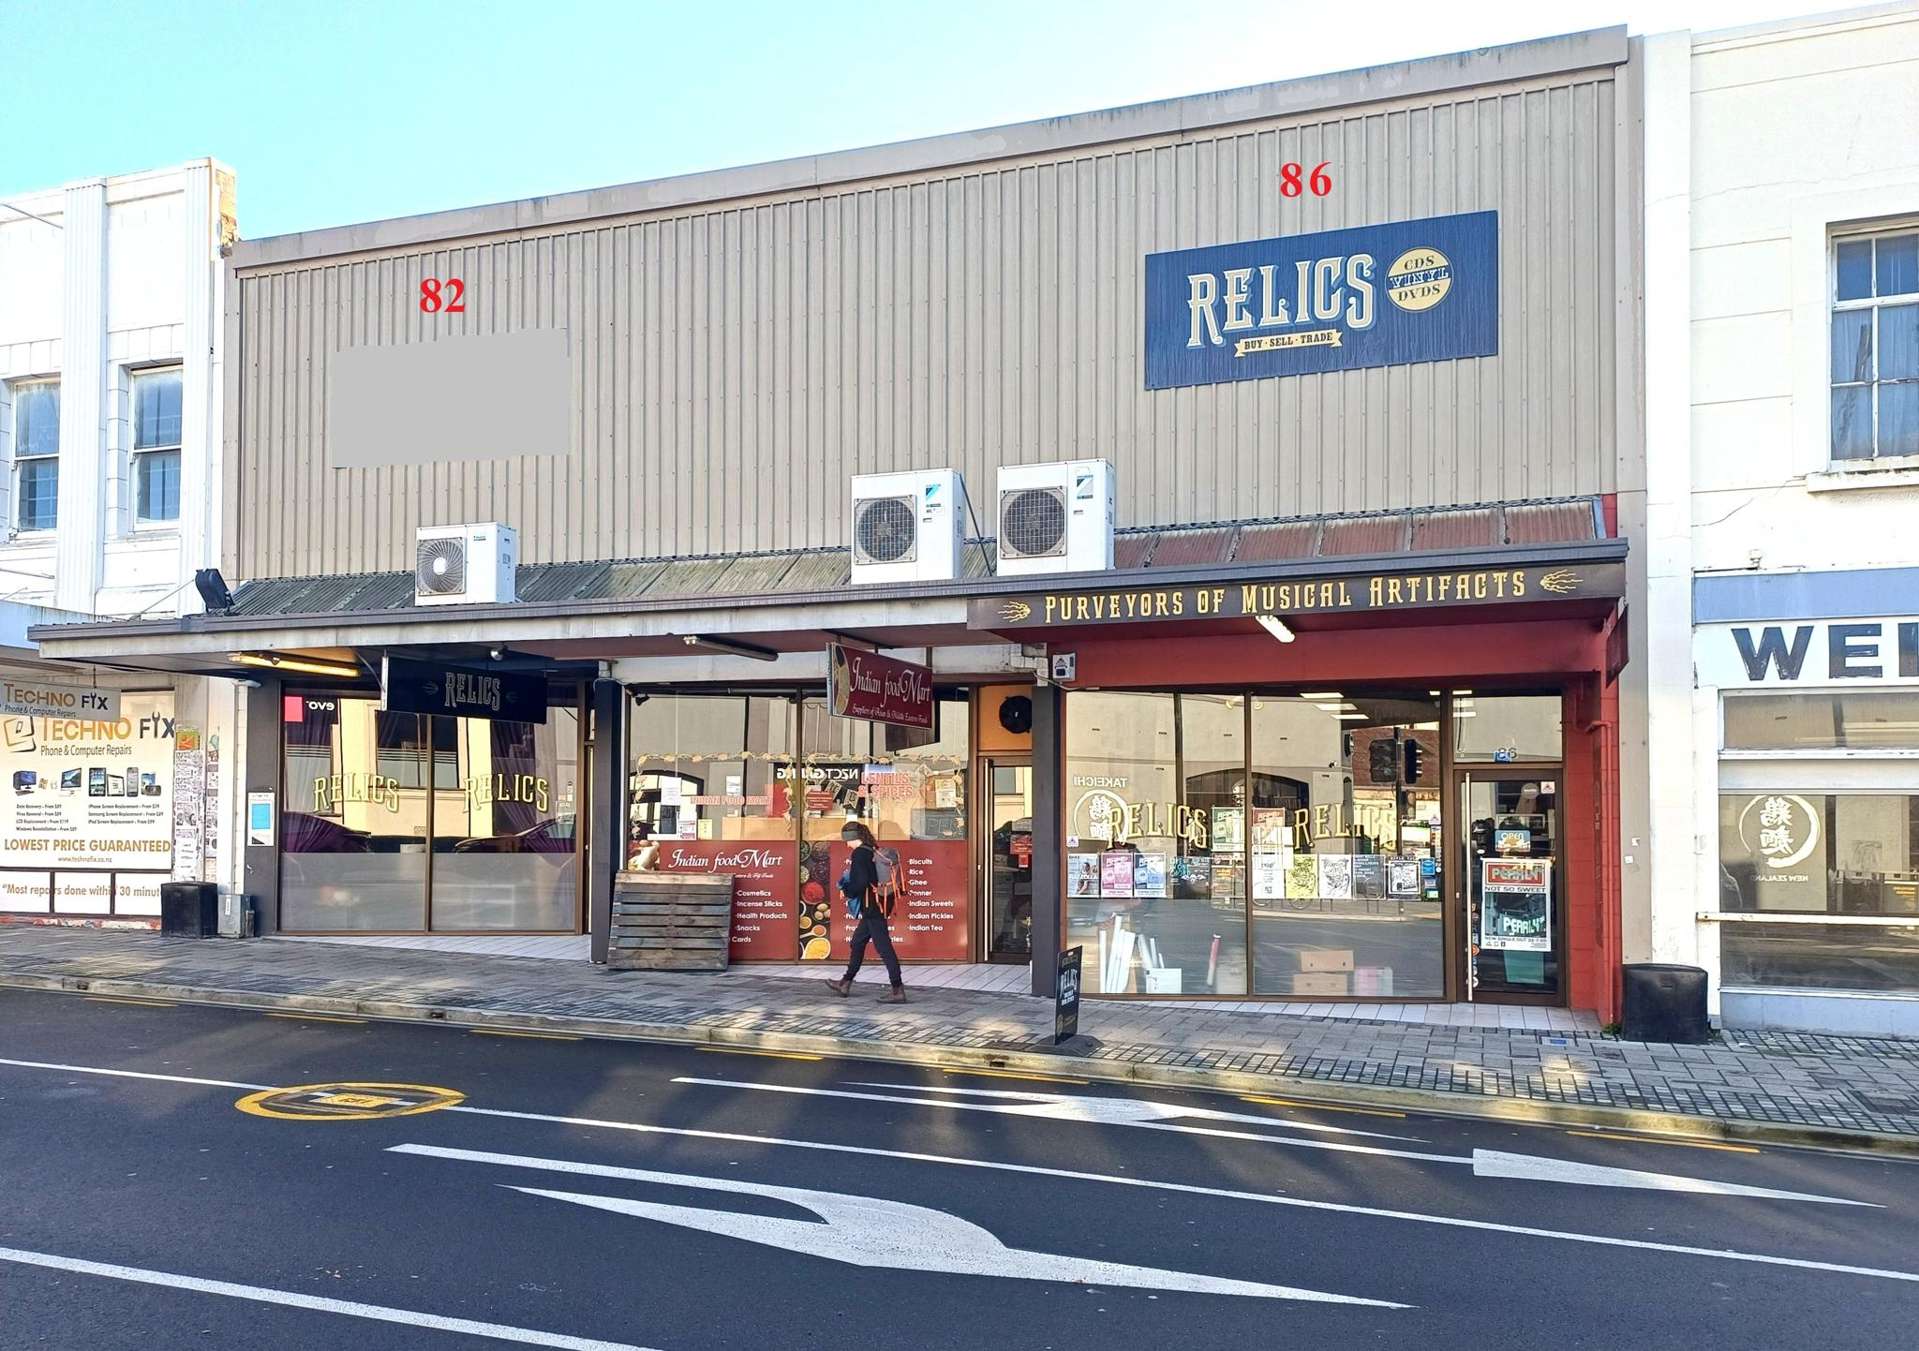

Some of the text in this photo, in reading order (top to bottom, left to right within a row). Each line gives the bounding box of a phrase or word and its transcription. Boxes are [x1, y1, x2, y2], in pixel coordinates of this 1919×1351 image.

[1404, 255, 1434, 271] CDS
[1390, 267, 1449, 288] VINYL
[1187, 253, 1376, 349] RELICS
[1398, 283, 1440, 302] DVDS
[1244, 332, 1333, 350] BUY SELL TRADE
[1045, 570, 1525, 623] PURVEYORS OF MUSICAL ARTIFACTS
[444, 671, 501, 711] RELICS
[850, 657, 881, 694] Indian
[900, 669, 930, 704] Mart
[4, 683, 109, 711] TECHNO FIX
[42, 711, 175, 741] TECHNO FIX
[41, 745, 63, 756] Phone
[69, 745, 106, 758] Computer
[106, 744, 132, 758] Repairs
[313, 772, 400, 813] RELICS
[463, 773, 548, 813] RELICS
[1107, 801, 1208, 849] RELICS
[1294, 803, 1398, 851] RELICS
[1501, 832, 1524, 841] OPEN
[4, 838, 171, 852] LOWEST PRICE GUARANTEED
[668, 849, 783, 873] Indian food Mart
[30, 885, 61, 897] repars
[64, 884, 86, 896] done
[89, 885, 117, 896] withi
[120, 886, 131, 897] 30
[737, 912, 788, 920] Health Products
[909, 912, 954, 920] Indian Pickles
